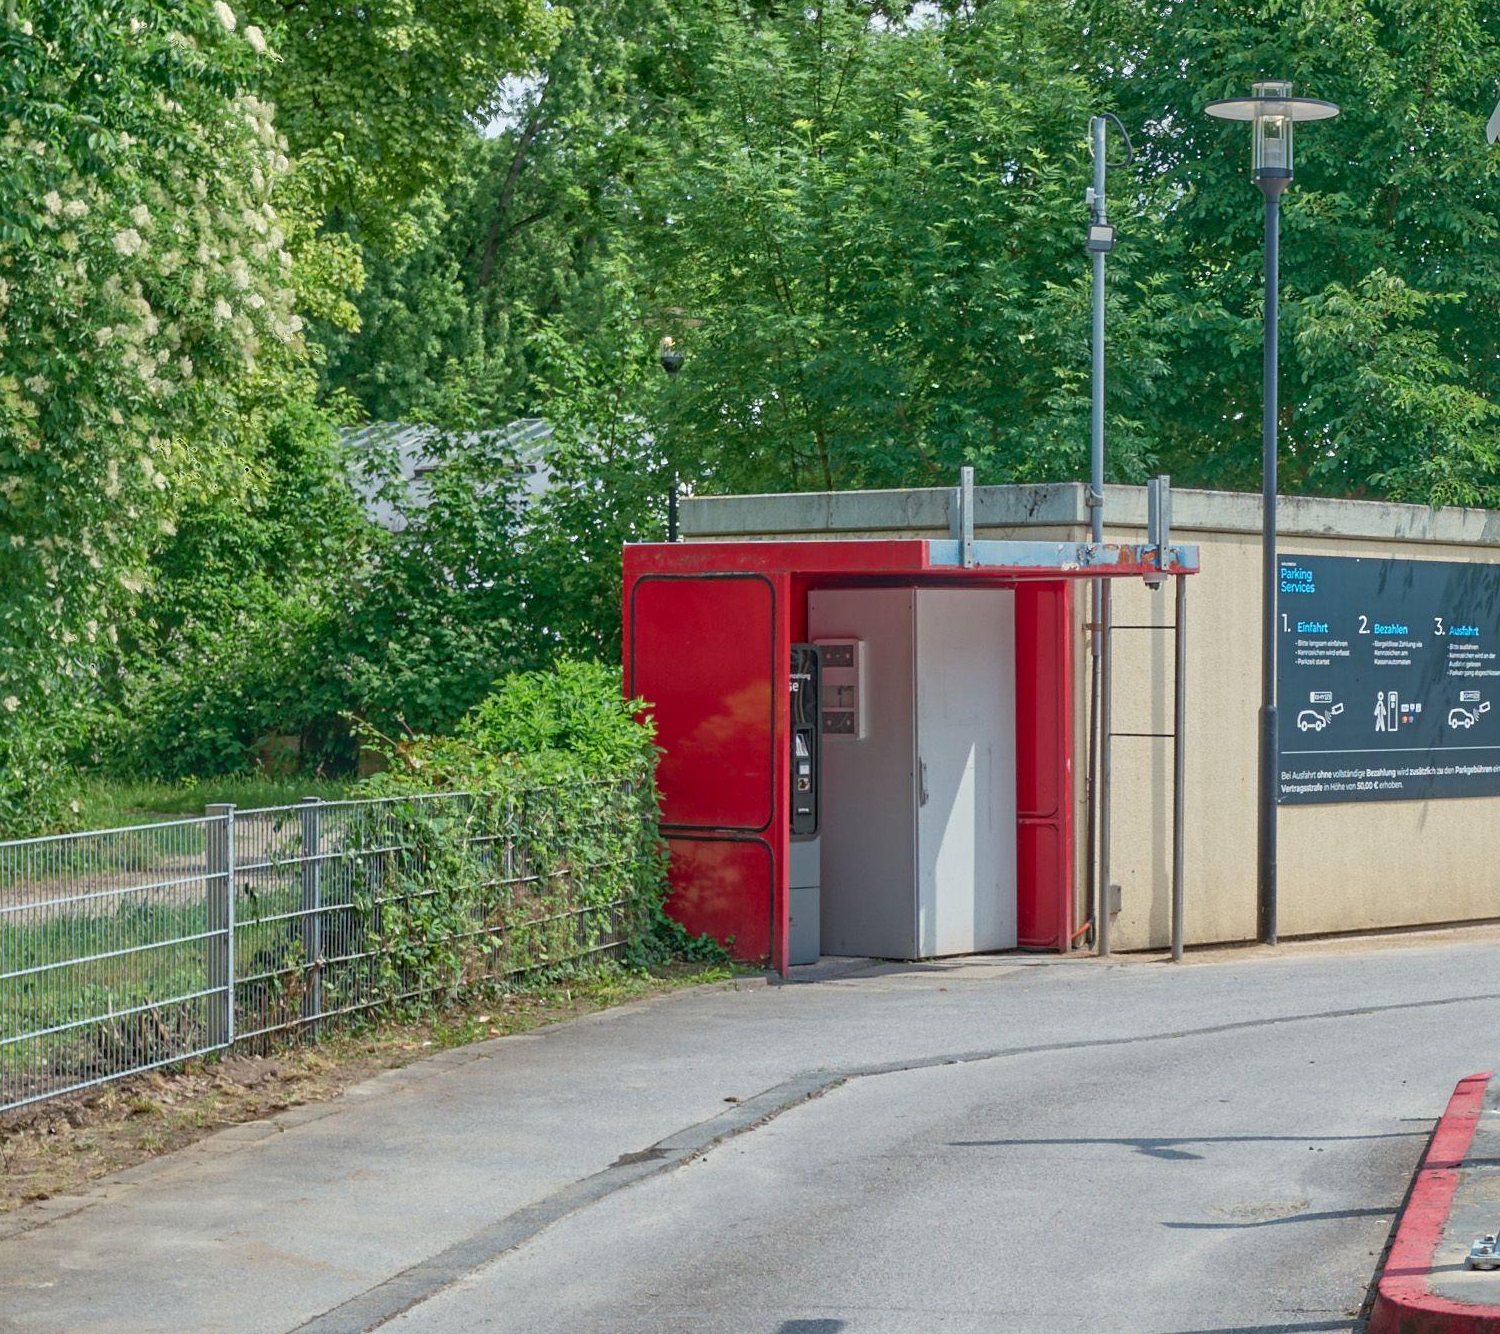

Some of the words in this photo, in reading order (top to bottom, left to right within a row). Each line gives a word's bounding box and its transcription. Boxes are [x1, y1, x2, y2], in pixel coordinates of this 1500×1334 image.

[1280, 568, 1312, 582] Parking
[1280, 581, 1316, 593] Services
[1282, 613, 1292, 632] 1.
[1297, 622, 1329, 633] Einfahrt
[1358, 614, 1370, 634] 2.
[1374, 624, 1408, 635] Bezahlen
[1434, 617, 1446, 636] 3.
[1448, 626, 1480, 636] Ausfahrt
[1281, 771, 1292, 780] Bei
[1292, 770, 1316, 780] Ausfahrt
[1316, 770, 1332, 779] ohne
[1332, 768, 1366, 780] vollständige
[1366, 768, 1396, 778] Bezahlung
[1396, 767, 1410, 776] wird
[1444, 766, 1454, 774] den
[1280, 782, 1324, 794] Vertragsstrafe
[1324, 782, 1330, 791] in
[1330, 782, 1345, 791] Höhe
[1345, 783, 1356, 791] von
[1356, 781, 1373, 791] 50,00
[1373, 780, 1379, 790] €
[1378, 780, 1404, 790] erhoben.
